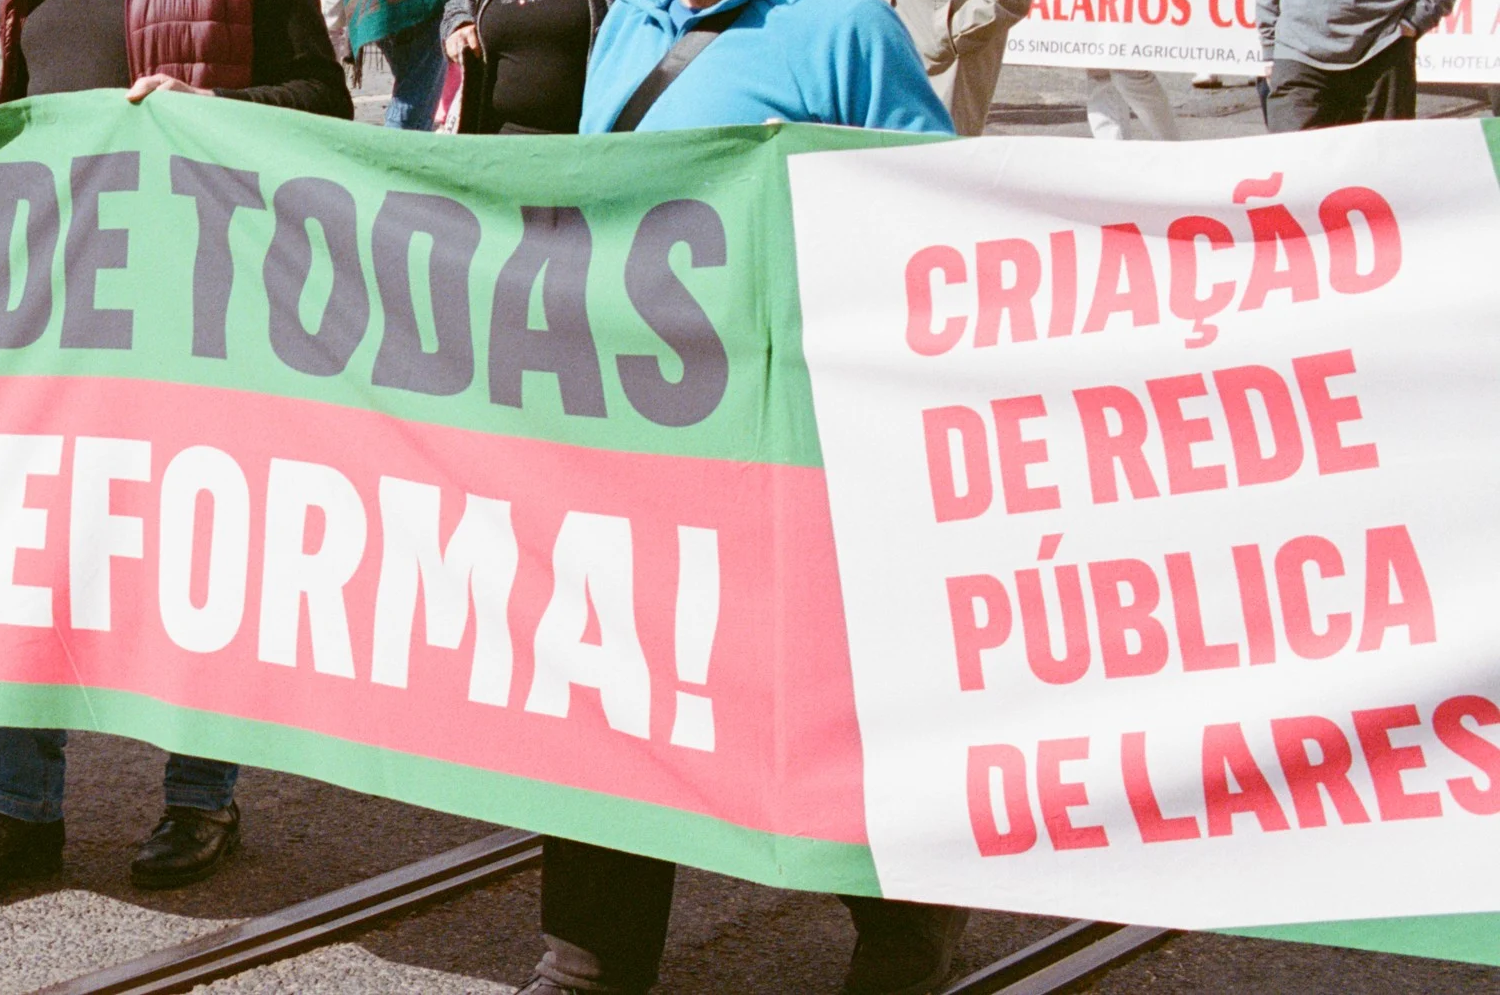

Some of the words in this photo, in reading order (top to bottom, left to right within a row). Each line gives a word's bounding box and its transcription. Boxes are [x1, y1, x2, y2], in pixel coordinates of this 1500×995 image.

[1028, 40, 1104, 56] SINDICATOS
[1108, 43, 1126, 57] DE
[1131, 44, 1241, 63] AGRICULTURA,
[169, 154, 729, 428] TODAS
[904, 172, 1403, 356] CRIAÇÃO
[921, 394, 1062, 524] DE
[1072, 348, 1380, 505] REDE
[945, 523, 1437, 692] PÚBLICA
[966, 736, 1110, 857] DE
[1120, 694, 1500, 845] LARES
